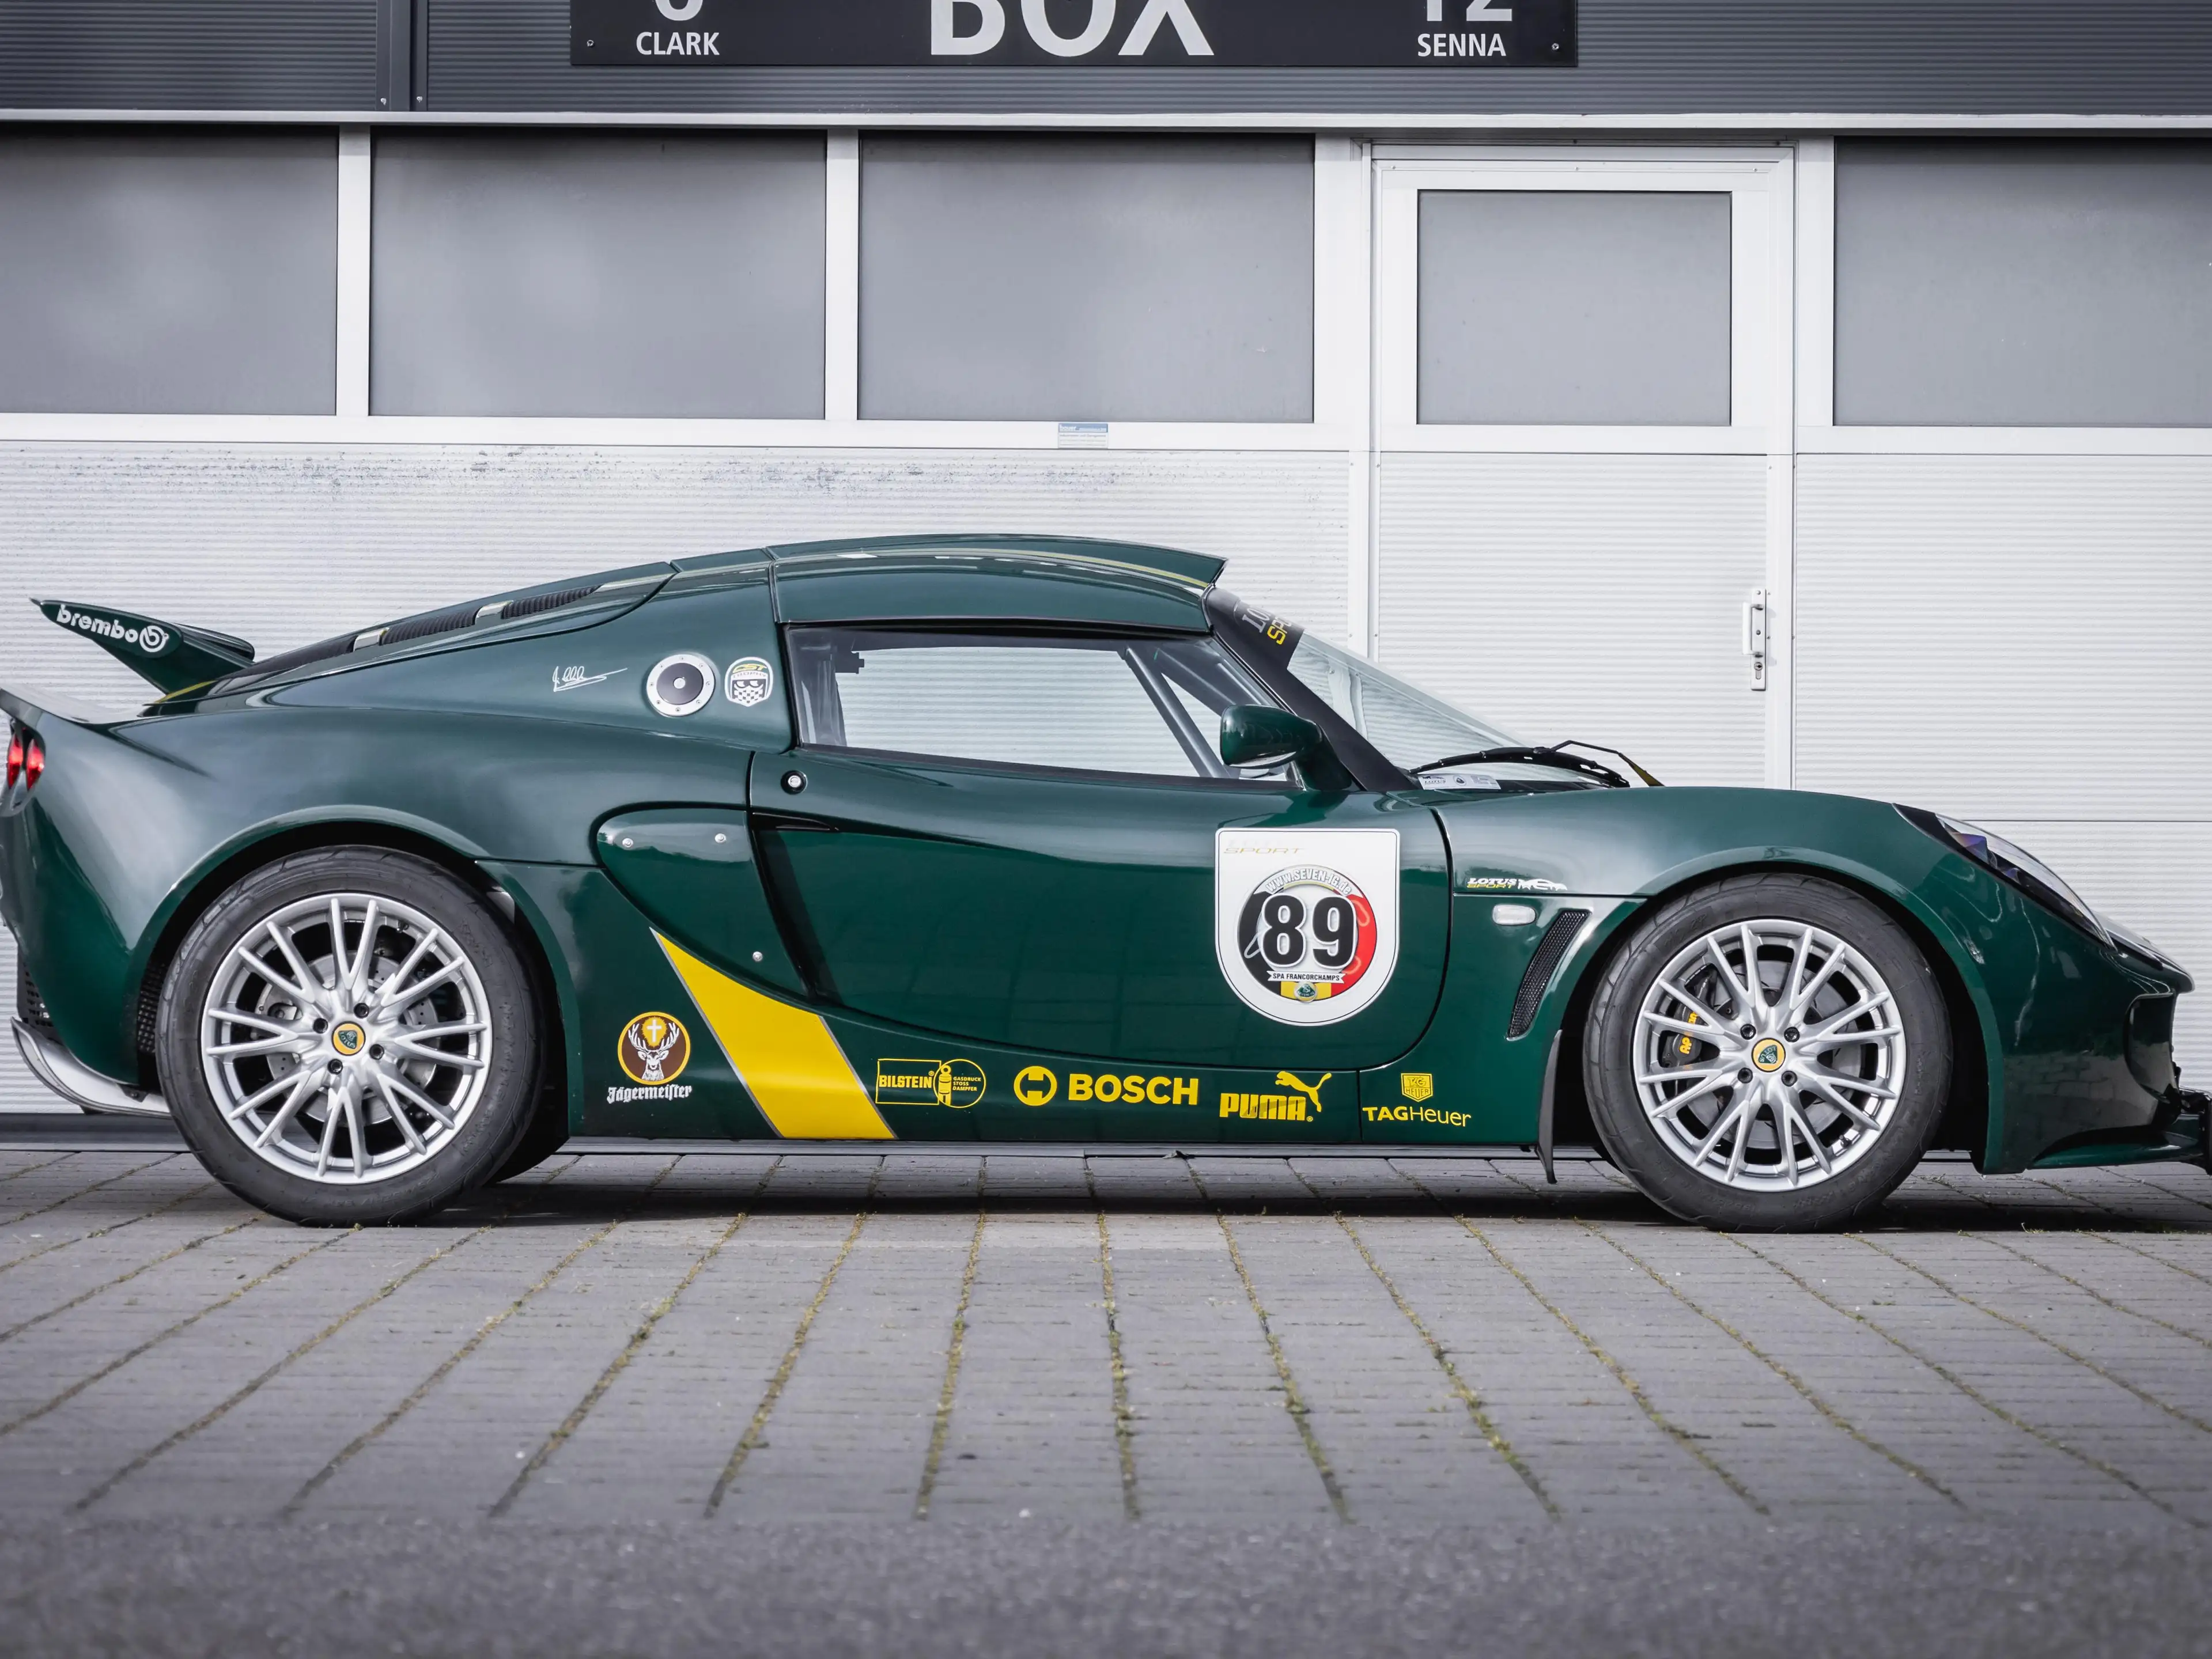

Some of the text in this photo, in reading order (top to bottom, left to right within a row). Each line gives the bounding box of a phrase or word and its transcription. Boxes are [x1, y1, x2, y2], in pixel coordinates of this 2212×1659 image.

[636, 32, 720, 55] CLARK
[1417, 33, 1507, 56] SENNA
[56, 604, 138, 643] brembo
[1242, 608, 1271, 633] LO
[1262, 895, 1355, 967] 89
[879, 1075, 932, 1088] BILSTEIN
[1068, 1073, 1199, 1105] BOSCH
[1406, 1088, 1429, 1098] HEUER
[1219, 1093, 1307, 1121] PUMA
